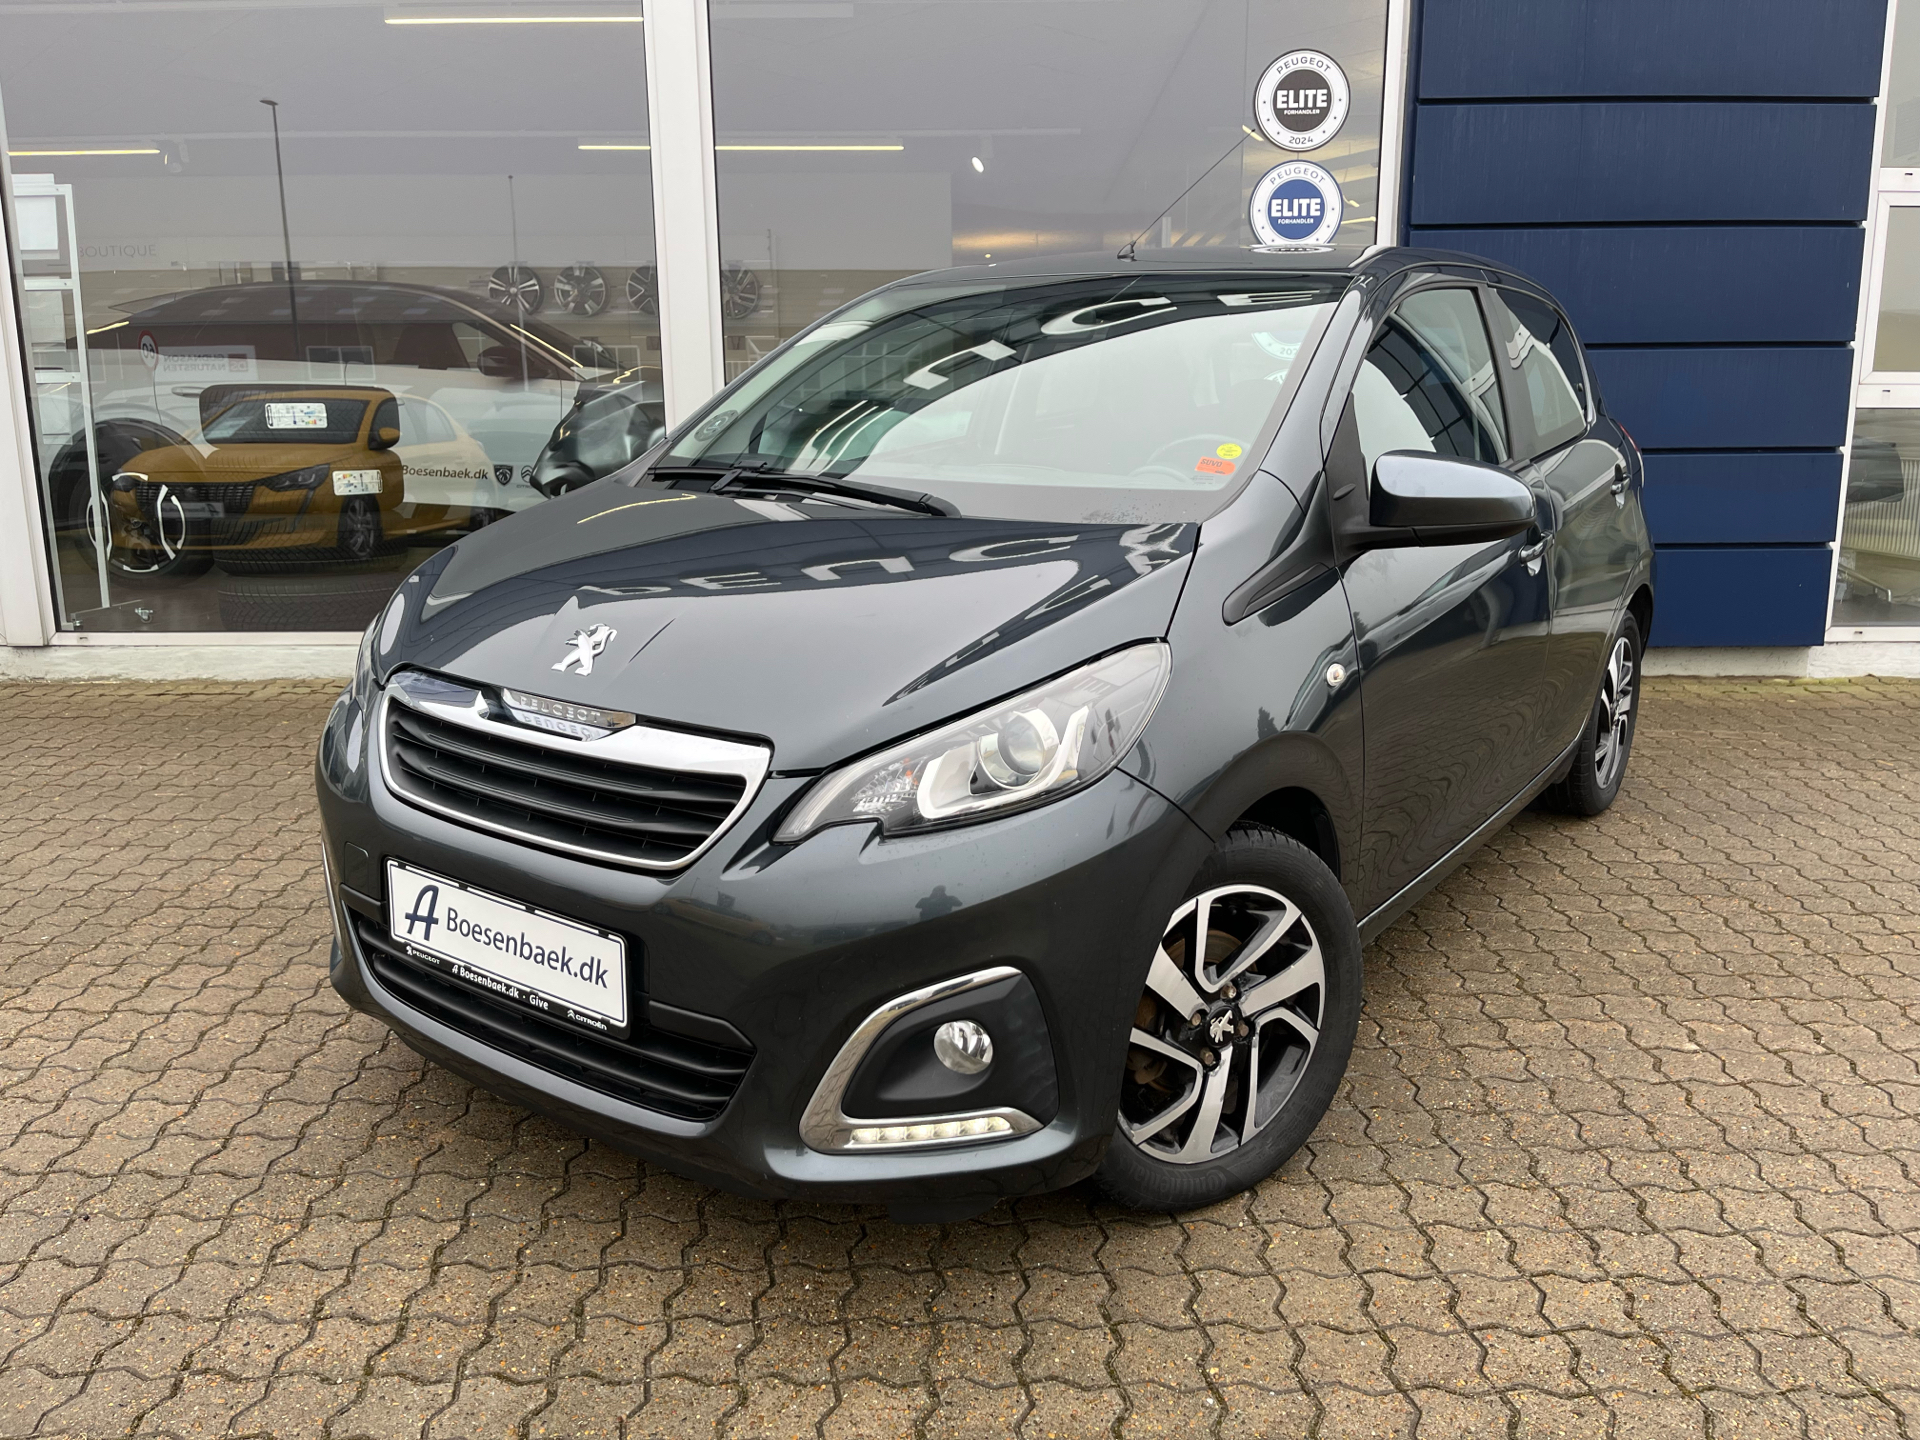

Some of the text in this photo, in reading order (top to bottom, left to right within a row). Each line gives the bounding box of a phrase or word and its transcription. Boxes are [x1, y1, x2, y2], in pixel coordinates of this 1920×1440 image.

[1276, 56, 1331, 75] PEUGEOT
[1277, 89, 1328, 109] ELITE
[1288, 135, 1314, 145] 2024
[1269, 167, 1326, 185] PEUGEOT
[1270, 197, 1321, 217] ELITE
[402, 465, 489, 480] Boesenbaek.dk
[519, 696, 600, 722] PEUGEOT
[404, 884, 609, 989] A Boesenbaek.dk
[412, 949, 440, 964] PEUGEOT
[460, 966, 520, 999] Boesenbaek.dk
[529, 994, 549, 1011] Give
